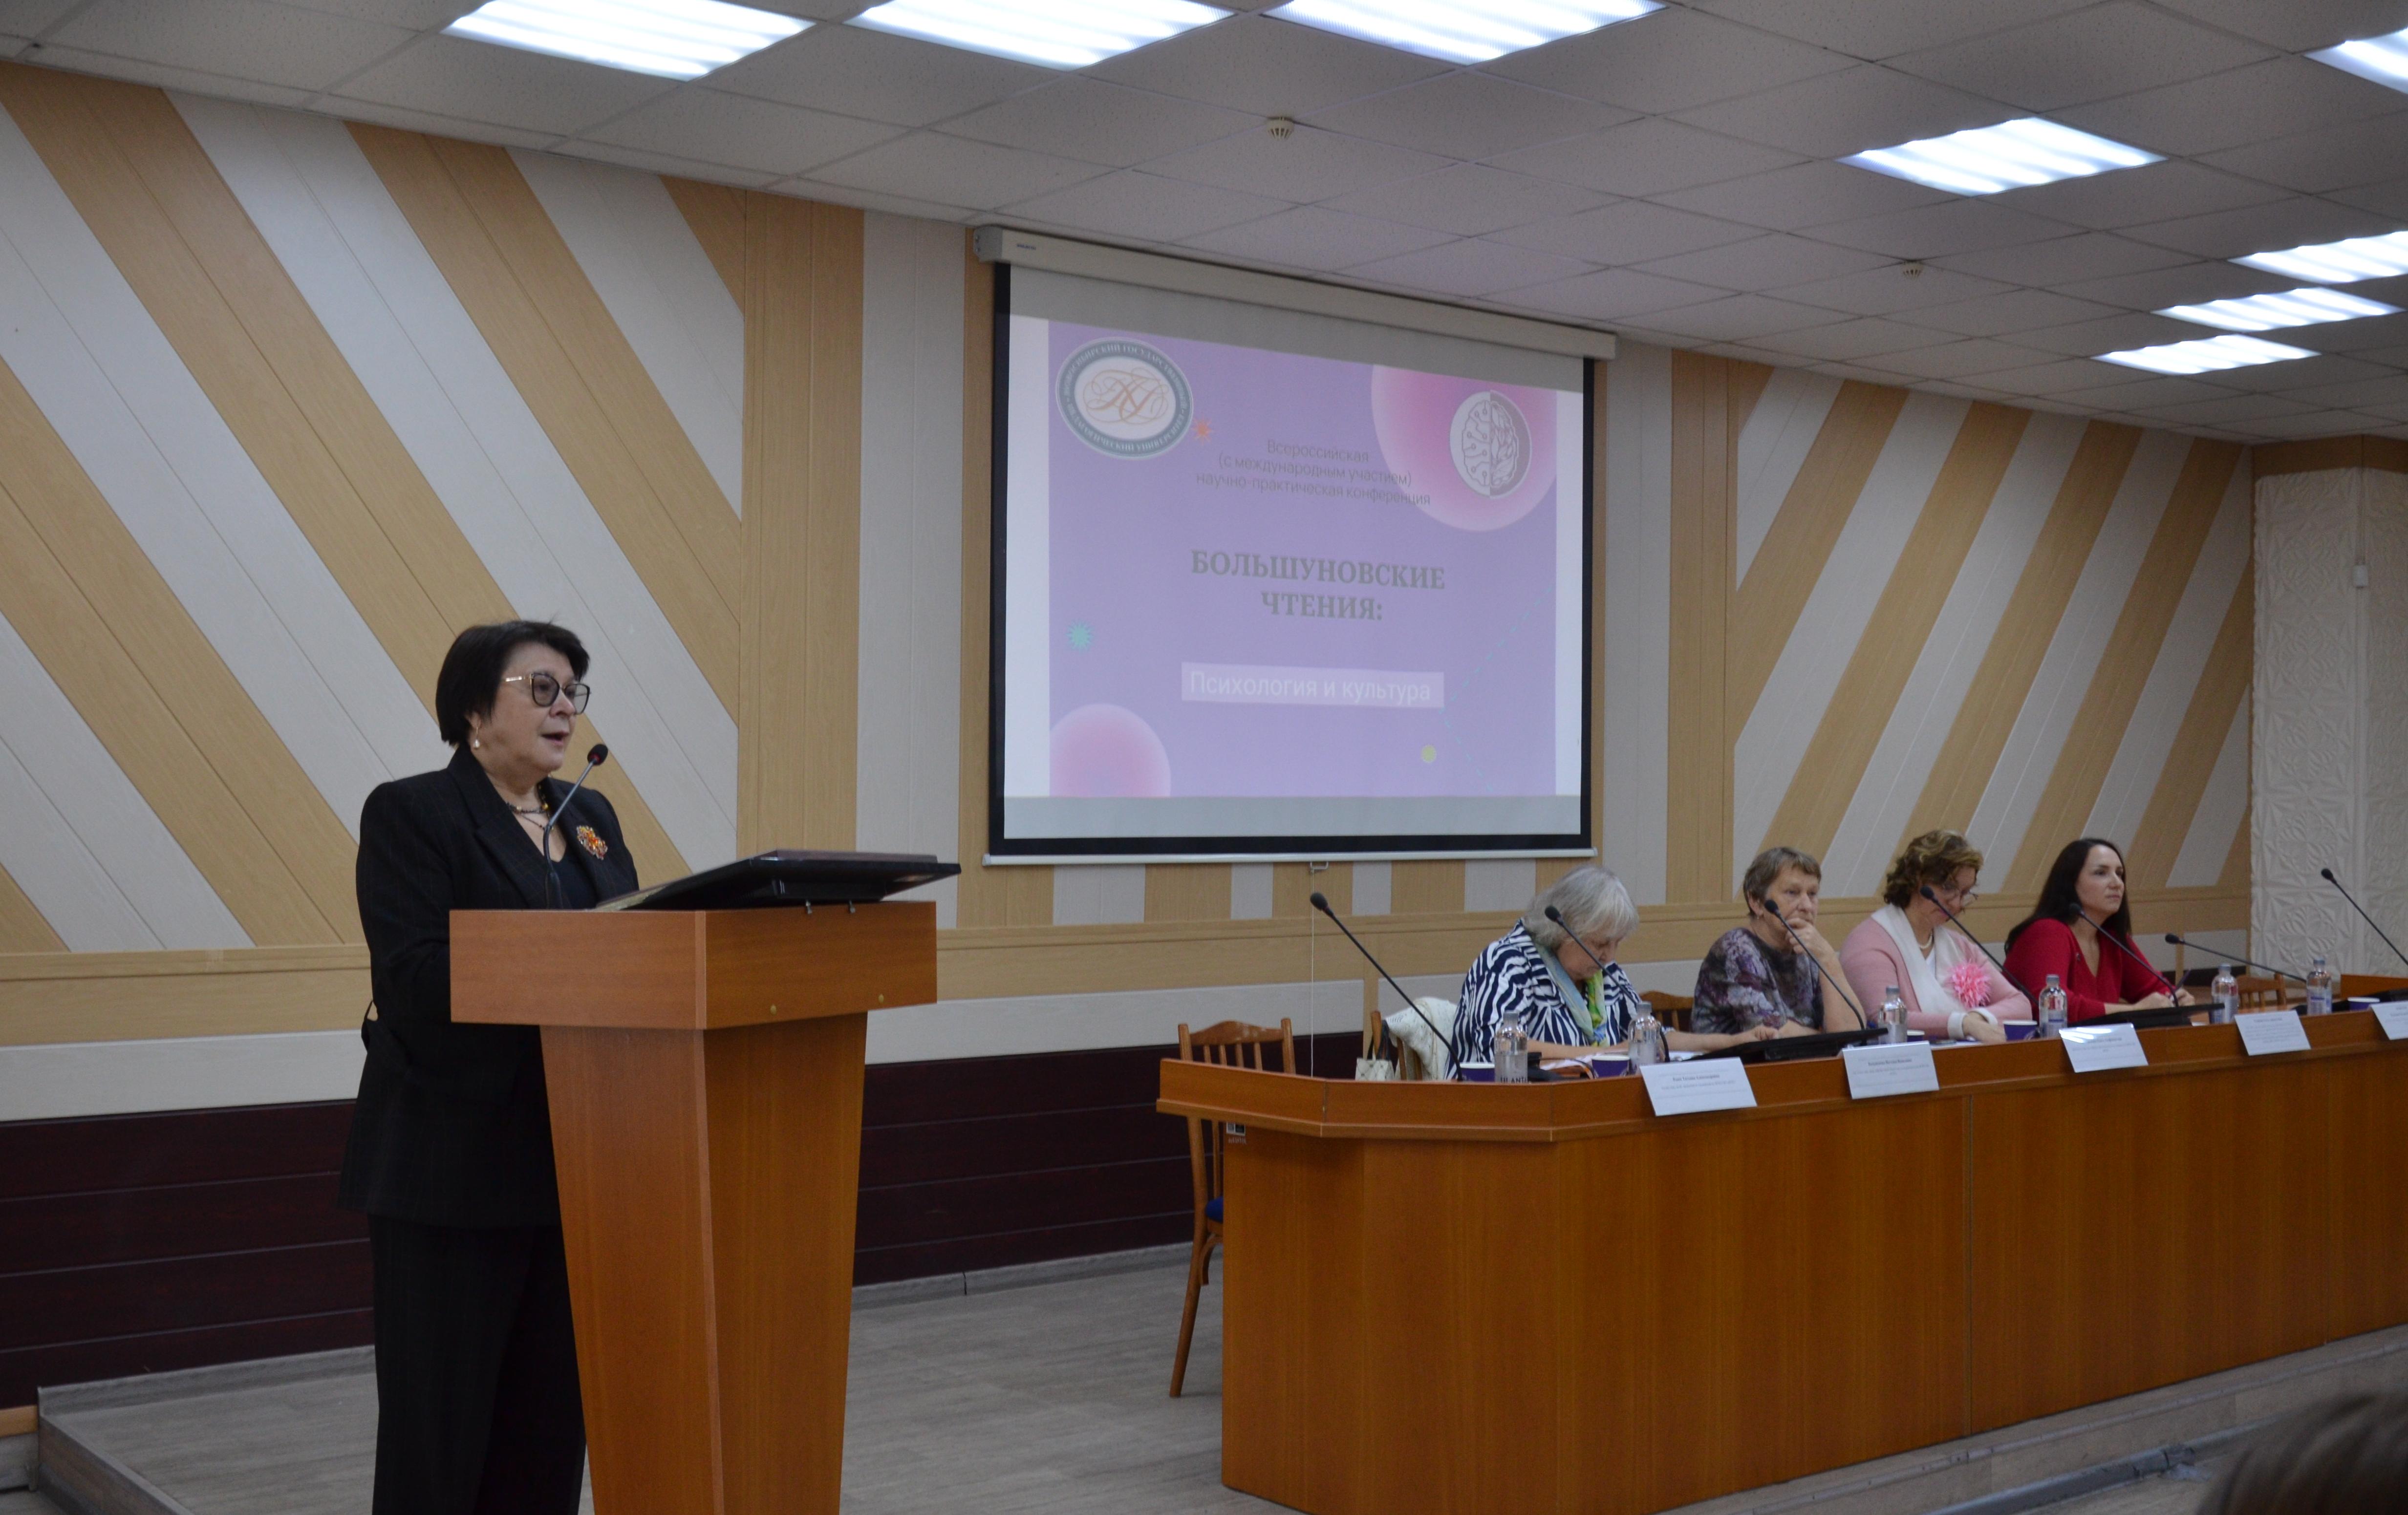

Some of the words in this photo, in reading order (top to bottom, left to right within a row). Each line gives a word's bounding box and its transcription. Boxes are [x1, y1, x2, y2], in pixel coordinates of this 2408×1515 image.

[1267, 440, 1369, 463] Всероссийская
[1219, 452, 1232, 469] (с
[1235, 456, 1346, 479] международным
[1349, 468, 1412, 488] участием)
[1196, 472, 1344, 497] научно-практическая
[1346, 486, 1431, 506] конференция
[1191, 550, 1445, 590] БОЛЬШУНОВСКИЕ
[1261, 591, 1383, 621] ЧТЕНИЯ:
[1190, 671, 1318, 698] Психология
[1323, 680, 1335, 698] и
[1343, 681, 1431, 704] культура
